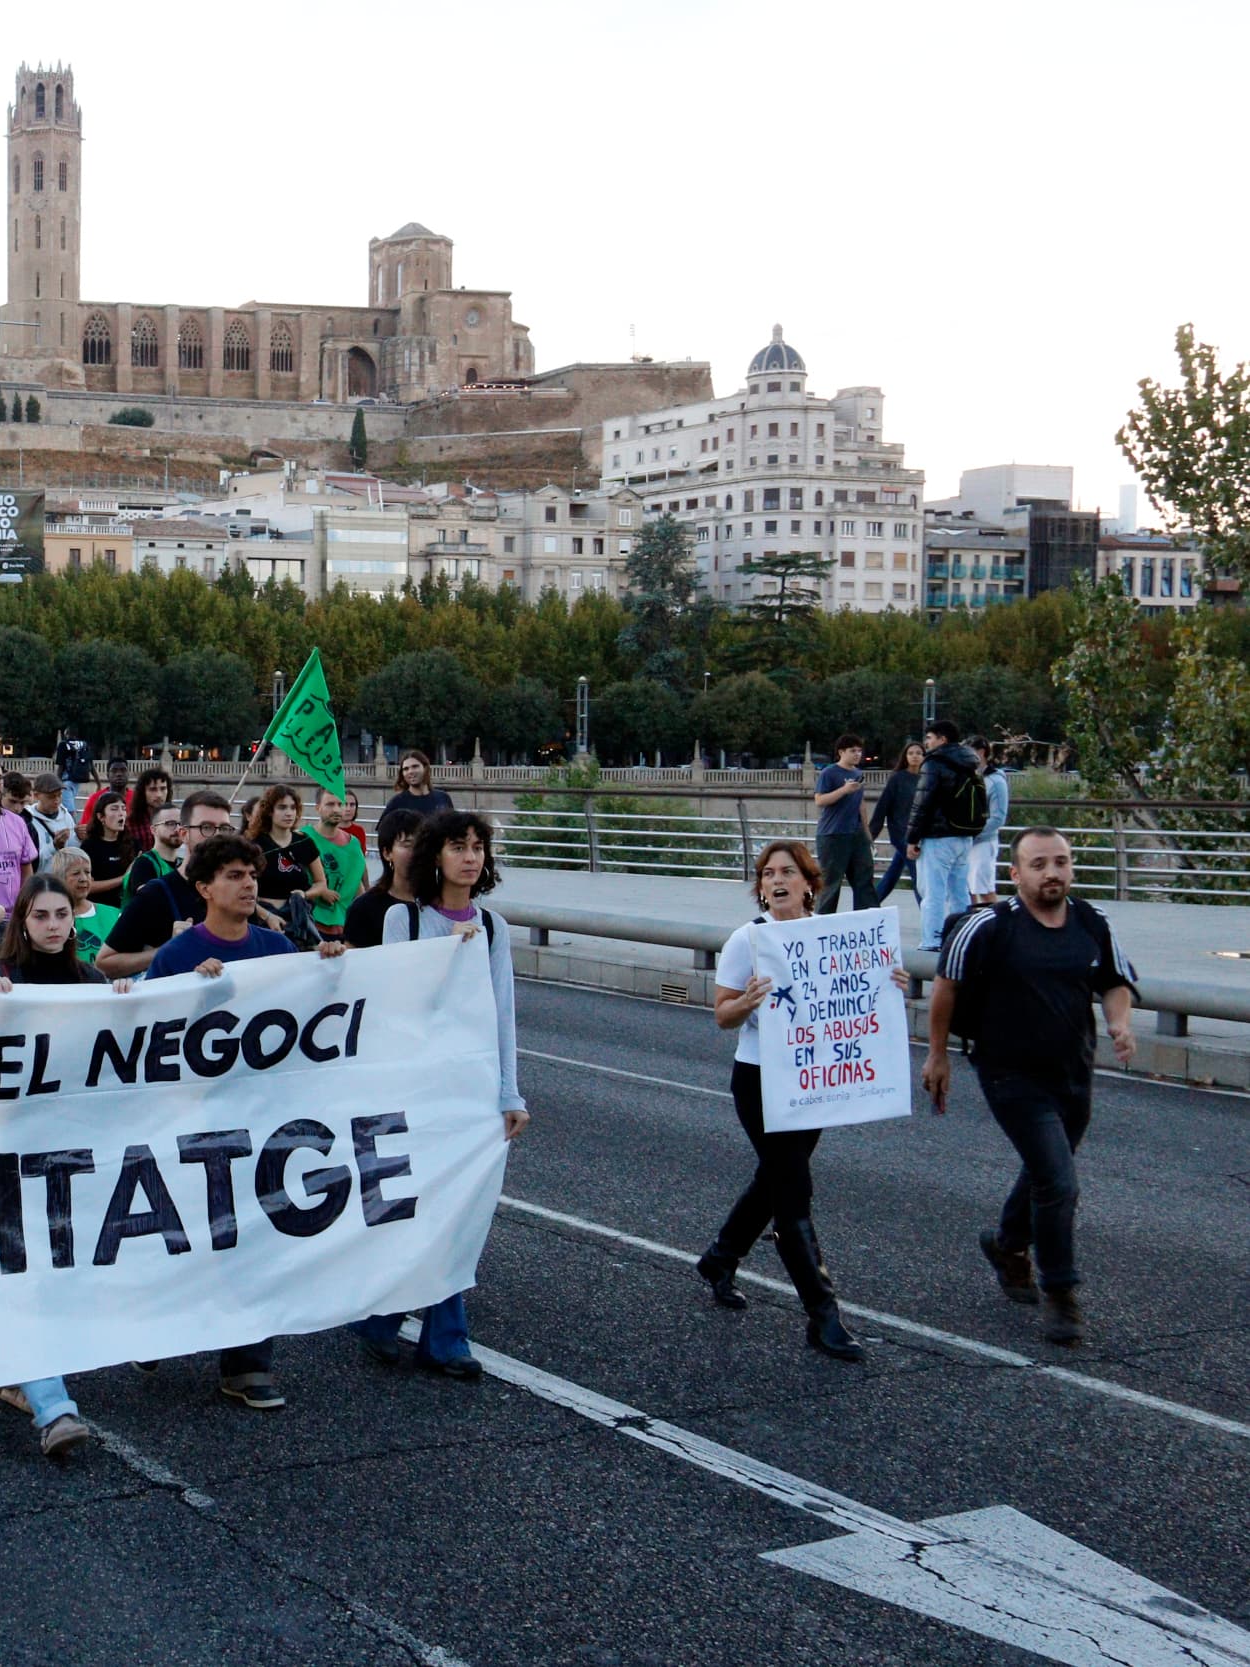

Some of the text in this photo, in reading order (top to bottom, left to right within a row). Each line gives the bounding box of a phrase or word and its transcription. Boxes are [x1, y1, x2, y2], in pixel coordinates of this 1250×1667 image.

[783, 919, 886, 960] YO TRABAJÉ
[792, 946, 898, 981] EN CAIXABANK
[802, 972, 871, 1000] 24 AÑOS
[787, 986, 880, 1023] Y DENUNCIÉ
[85, 998, 366, 1088] NEGOCI
[787, 1013, 879, 1046] LOS ABUSOS
[795, 1039, 862, 1067] EN SUS
[799, 1059, 876, 1090] OFICINAS
